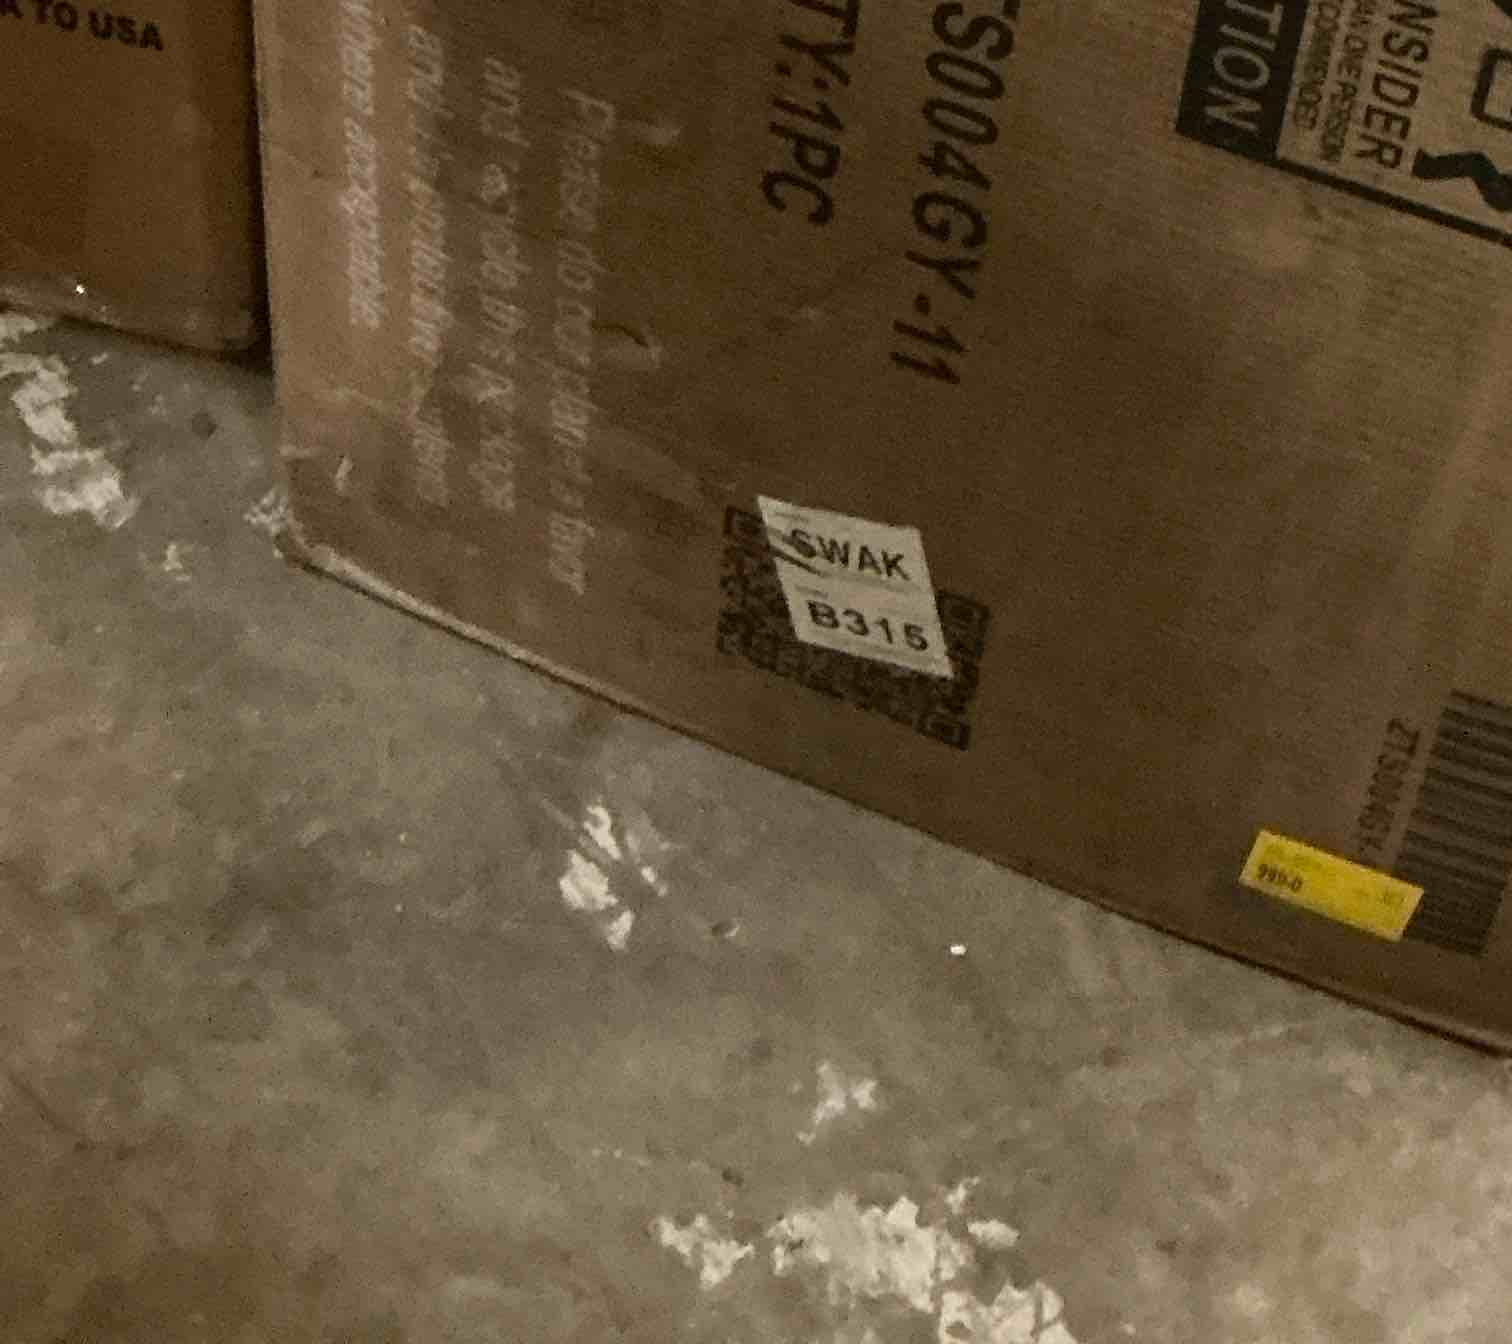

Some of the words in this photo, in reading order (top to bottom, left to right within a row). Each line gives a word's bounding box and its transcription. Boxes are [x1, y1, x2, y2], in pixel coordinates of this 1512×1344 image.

[87, 8, 165, 52] USA
[788, 528, 911, 582] SWAK
[806, 599, 929, 652] B315
